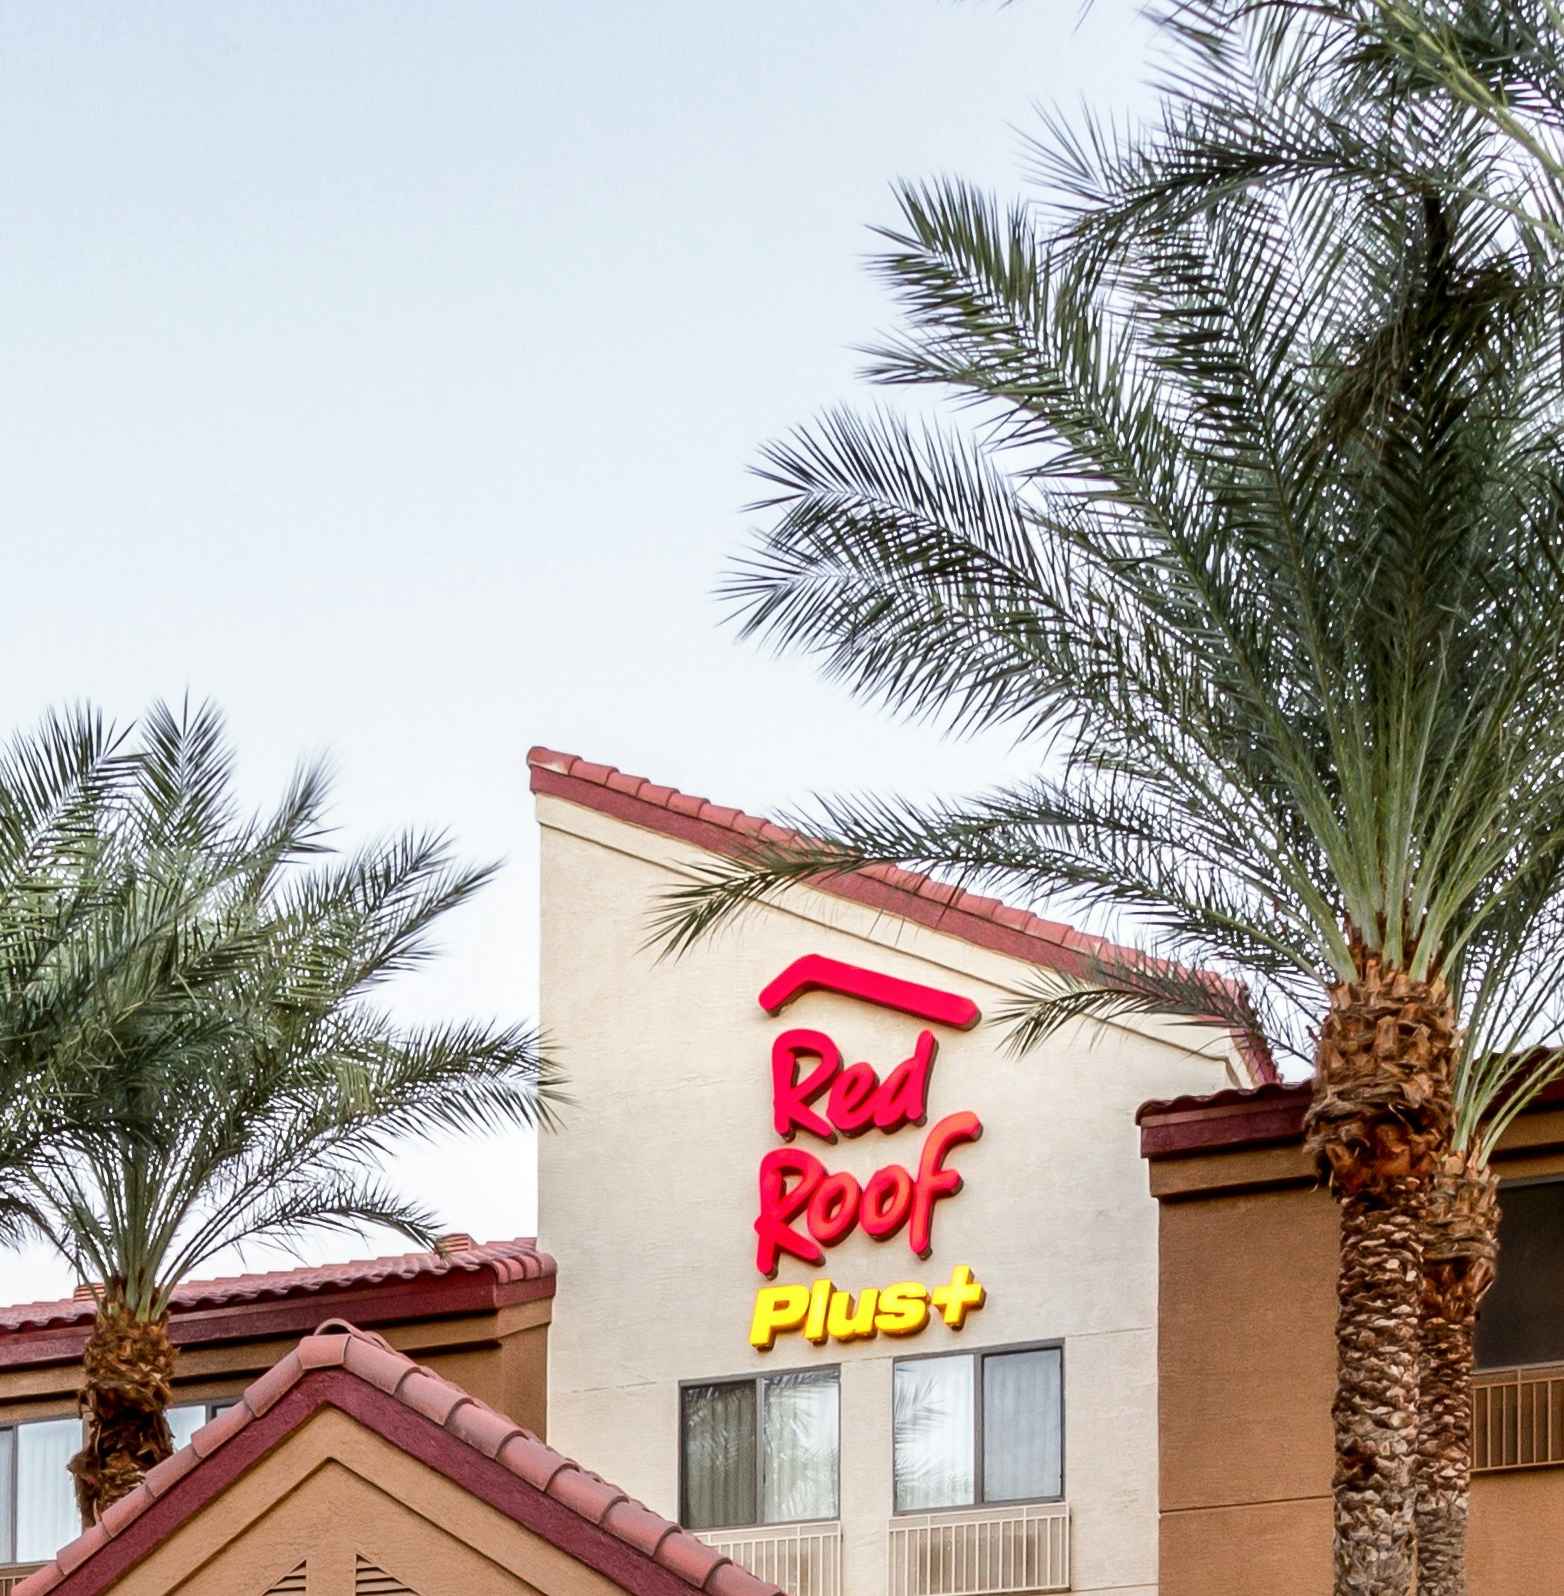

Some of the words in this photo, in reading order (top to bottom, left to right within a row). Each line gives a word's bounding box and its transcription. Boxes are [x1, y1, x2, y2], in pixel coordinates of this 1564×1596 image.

[772, 1029, 939, 1145] Red
[754, 1111, 984, 1280] Roof
[749, 1265, 986, 1350] Plus+
